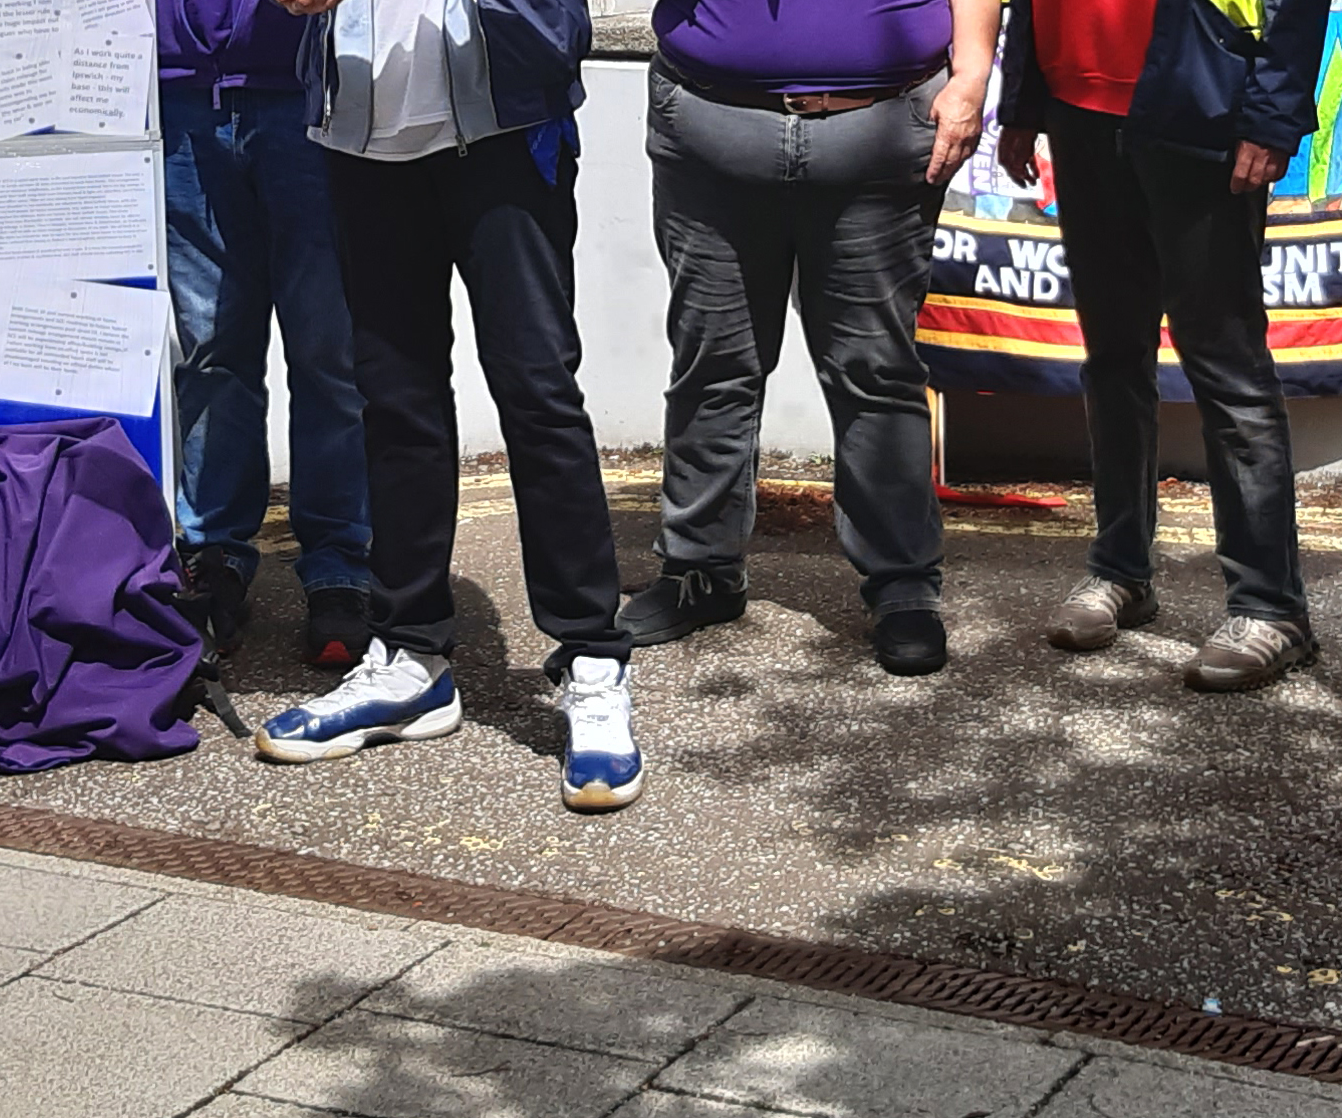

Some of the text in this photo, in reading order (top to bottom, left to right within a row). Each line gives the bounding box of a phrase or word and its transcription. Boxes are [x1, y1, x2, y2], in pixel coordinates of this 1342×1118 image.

[73, 60, 129, 70] distance from
[73, 71, 123, 83] Ipswich my
[98, 84, 112, 93] this
[70, 94, 93, 102] affect
[933, 228, 978, 262] OR
[974, 264, 1060, 301] AND
